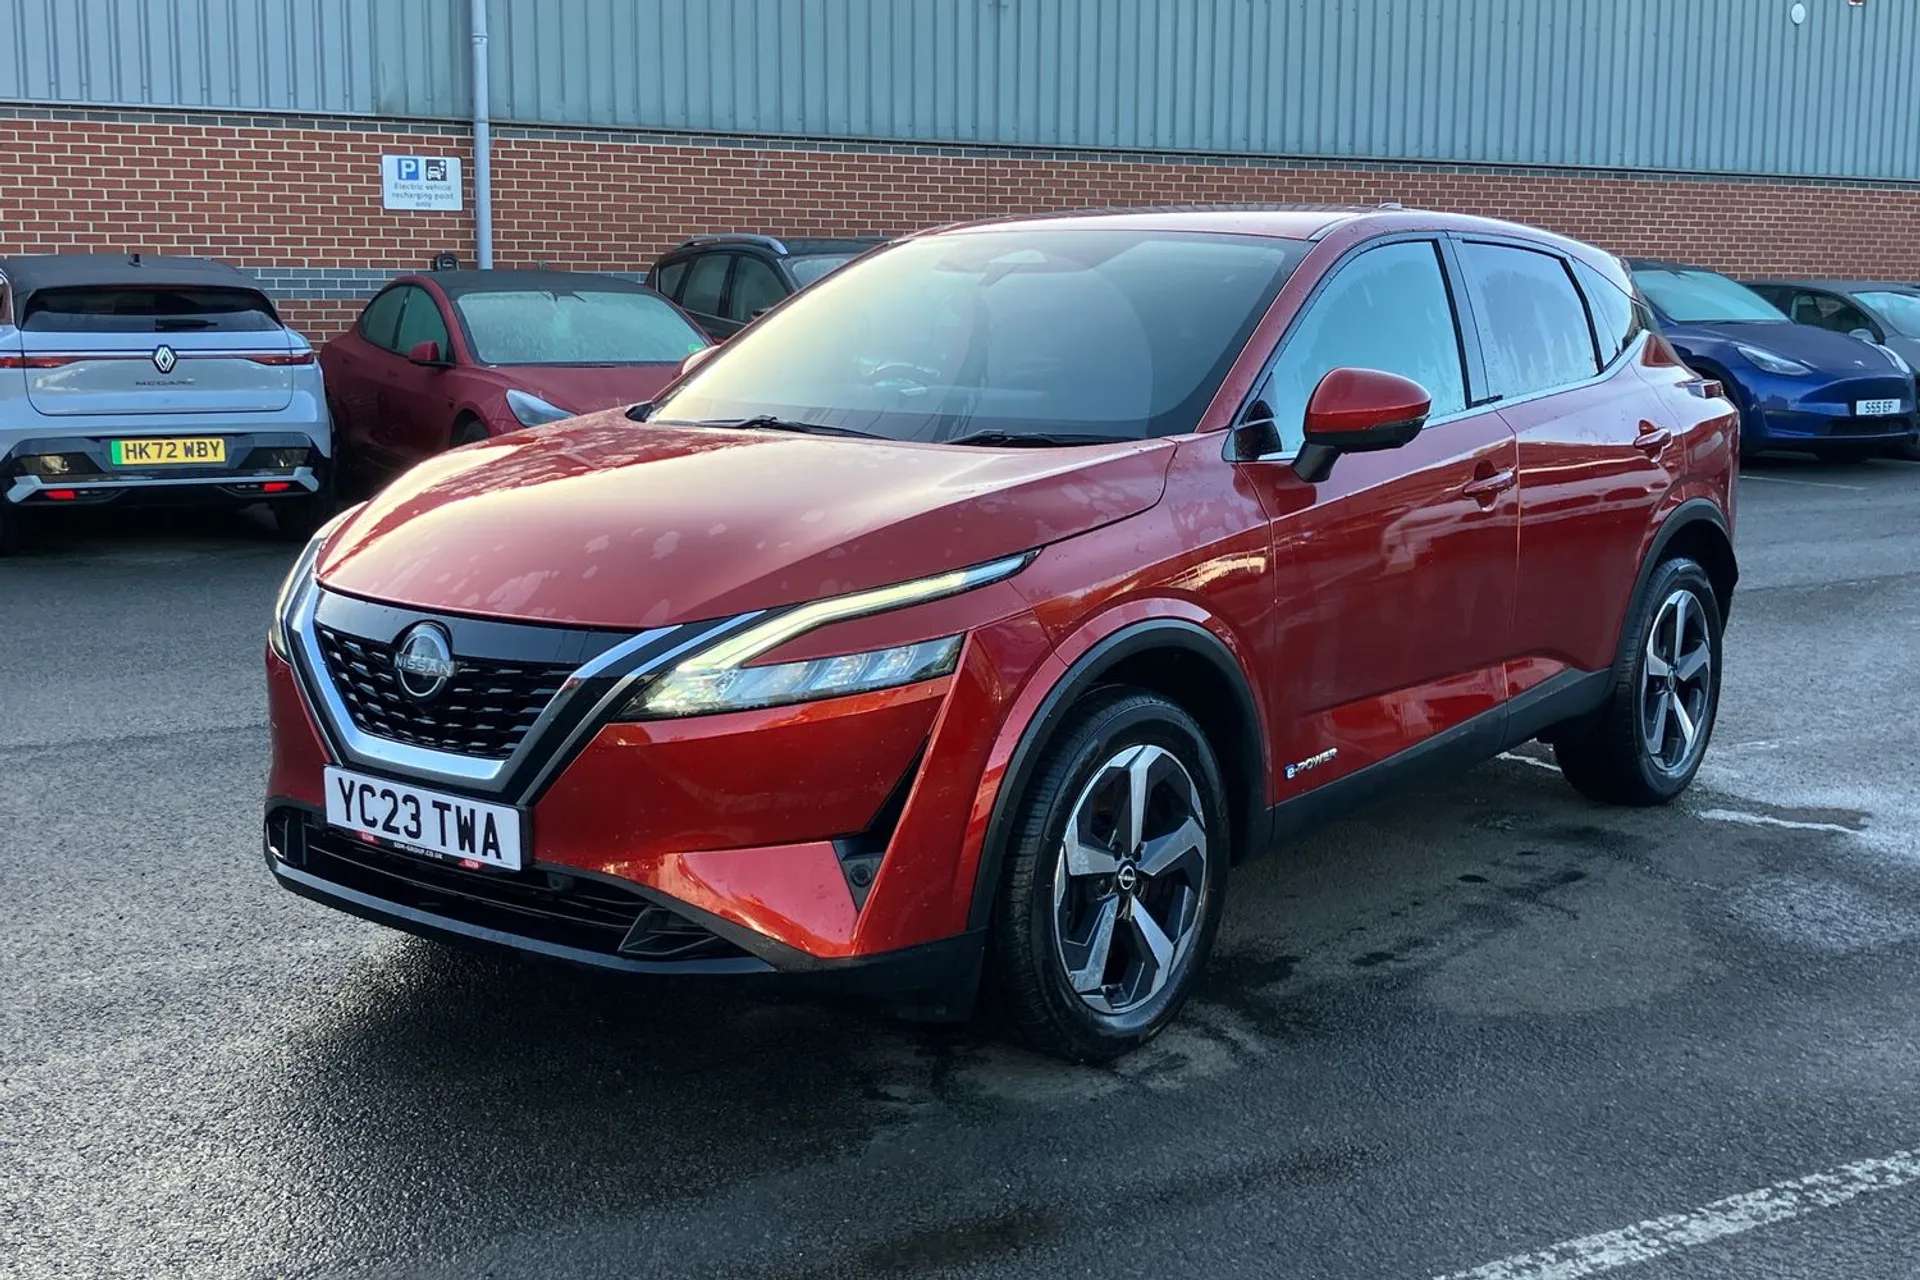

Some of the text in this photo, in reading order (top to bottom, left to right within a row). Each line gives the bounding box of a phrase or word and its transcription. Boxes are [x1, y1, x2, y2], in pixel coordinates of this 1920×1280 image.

[401, 160, 416, 179] P
[392, 192, 433, 201] recharging
[394, 183, 452, 192] Electric vehicle
[124, 440, 221, 460] HK72 WBY
[394, 652, 455, 677] NISSAN
[338, 777, 502, 860] YC23 TWA
